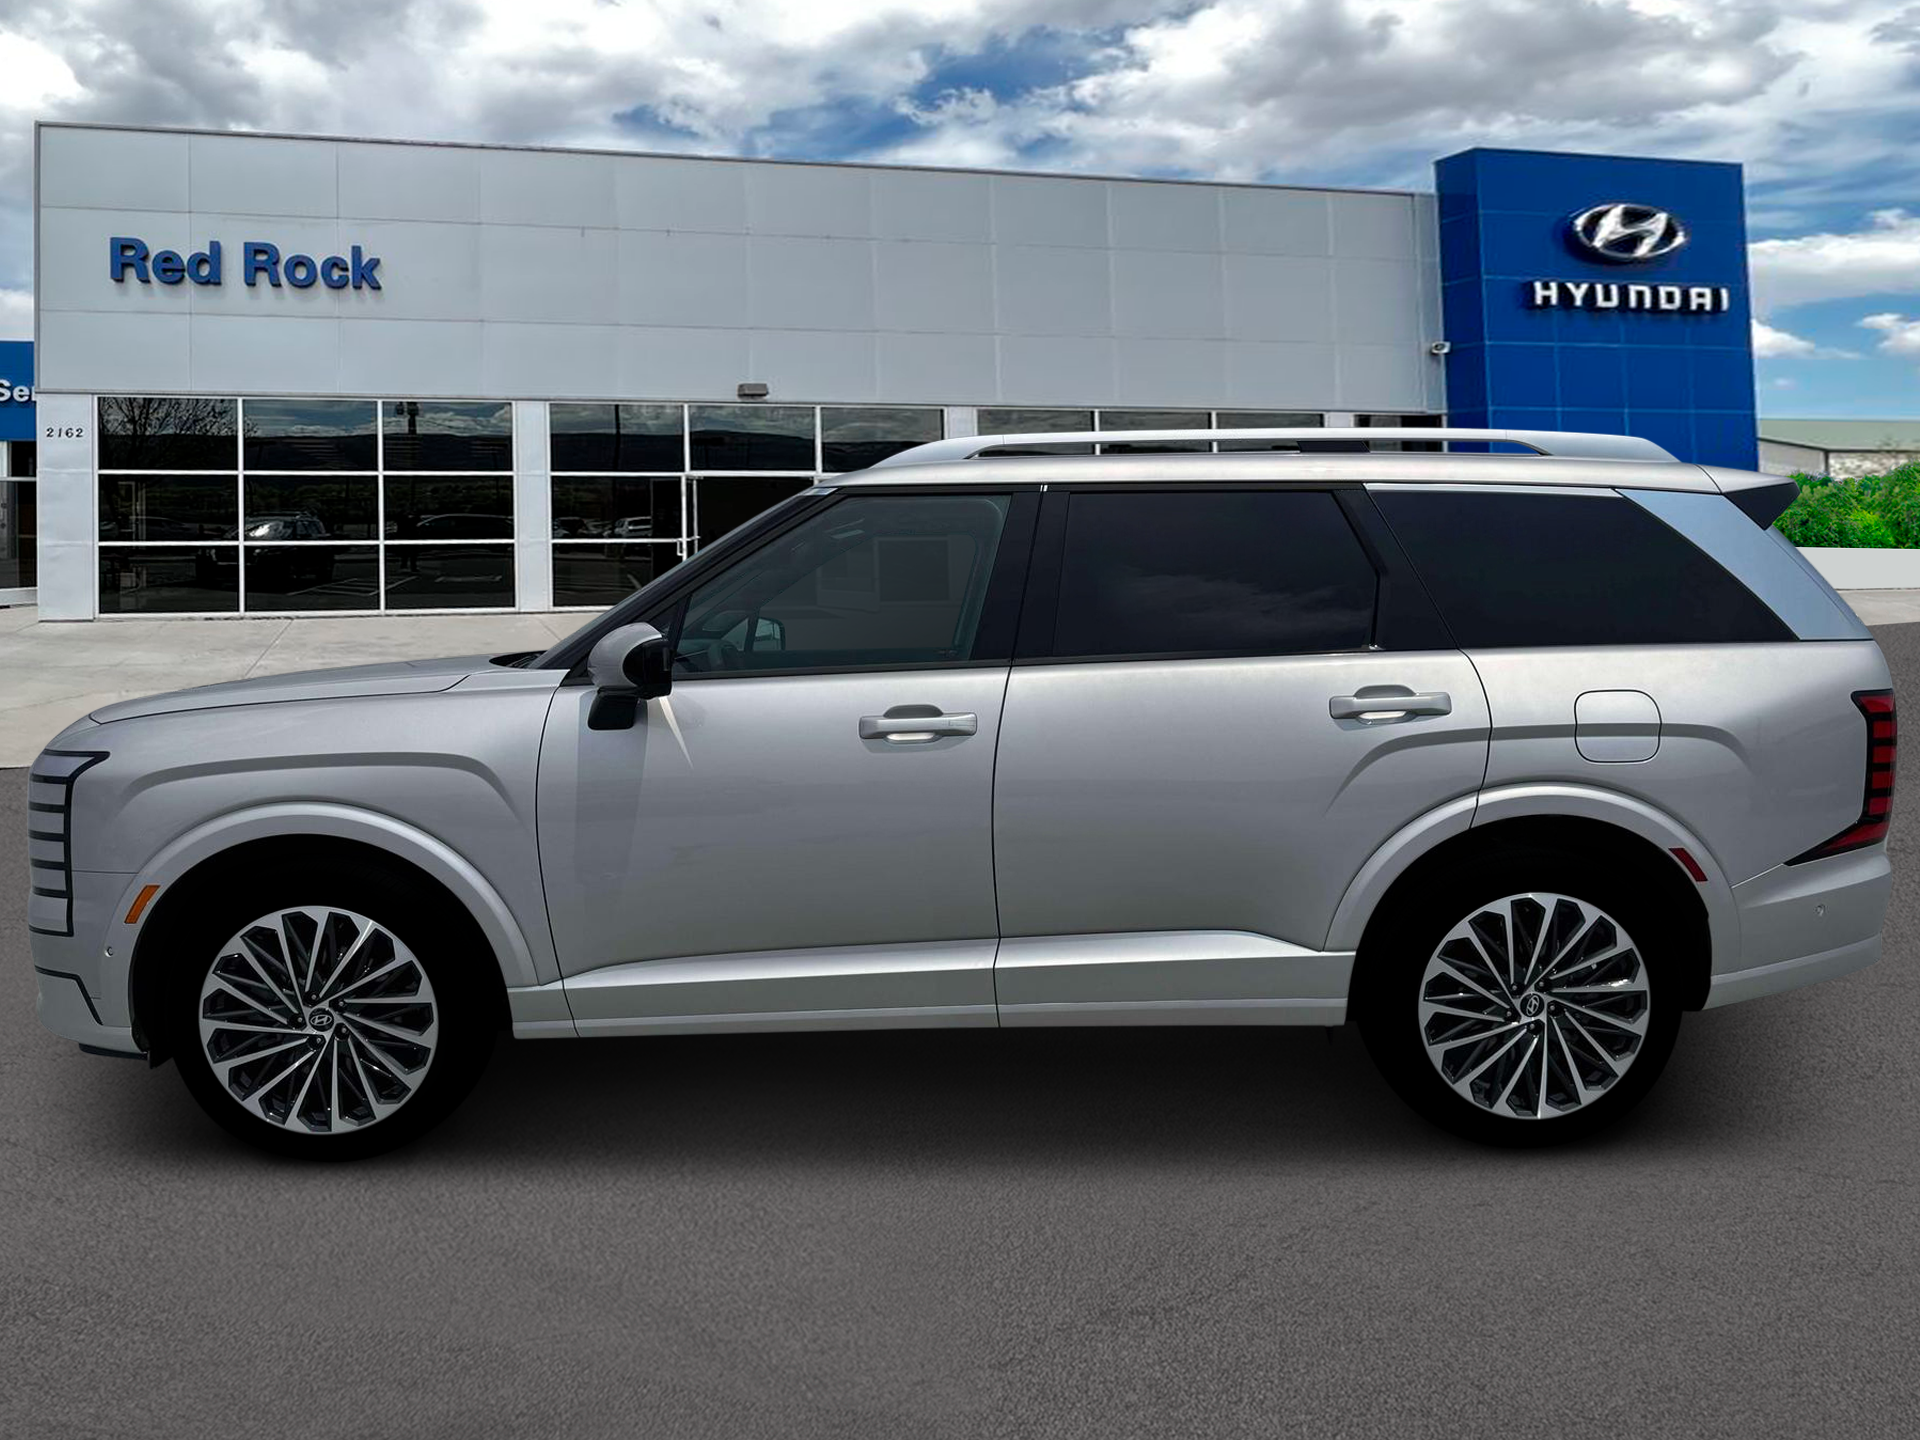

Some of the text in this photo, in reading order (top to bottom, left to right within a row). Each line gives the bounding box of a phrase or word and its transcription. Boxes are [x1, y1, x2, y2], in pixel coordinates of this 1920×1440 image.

[110, 237, 382, 290] Red Rock
[1533, 281, 1730, 311] HYUNDAI
[46, 427, 83, 438] 2162
